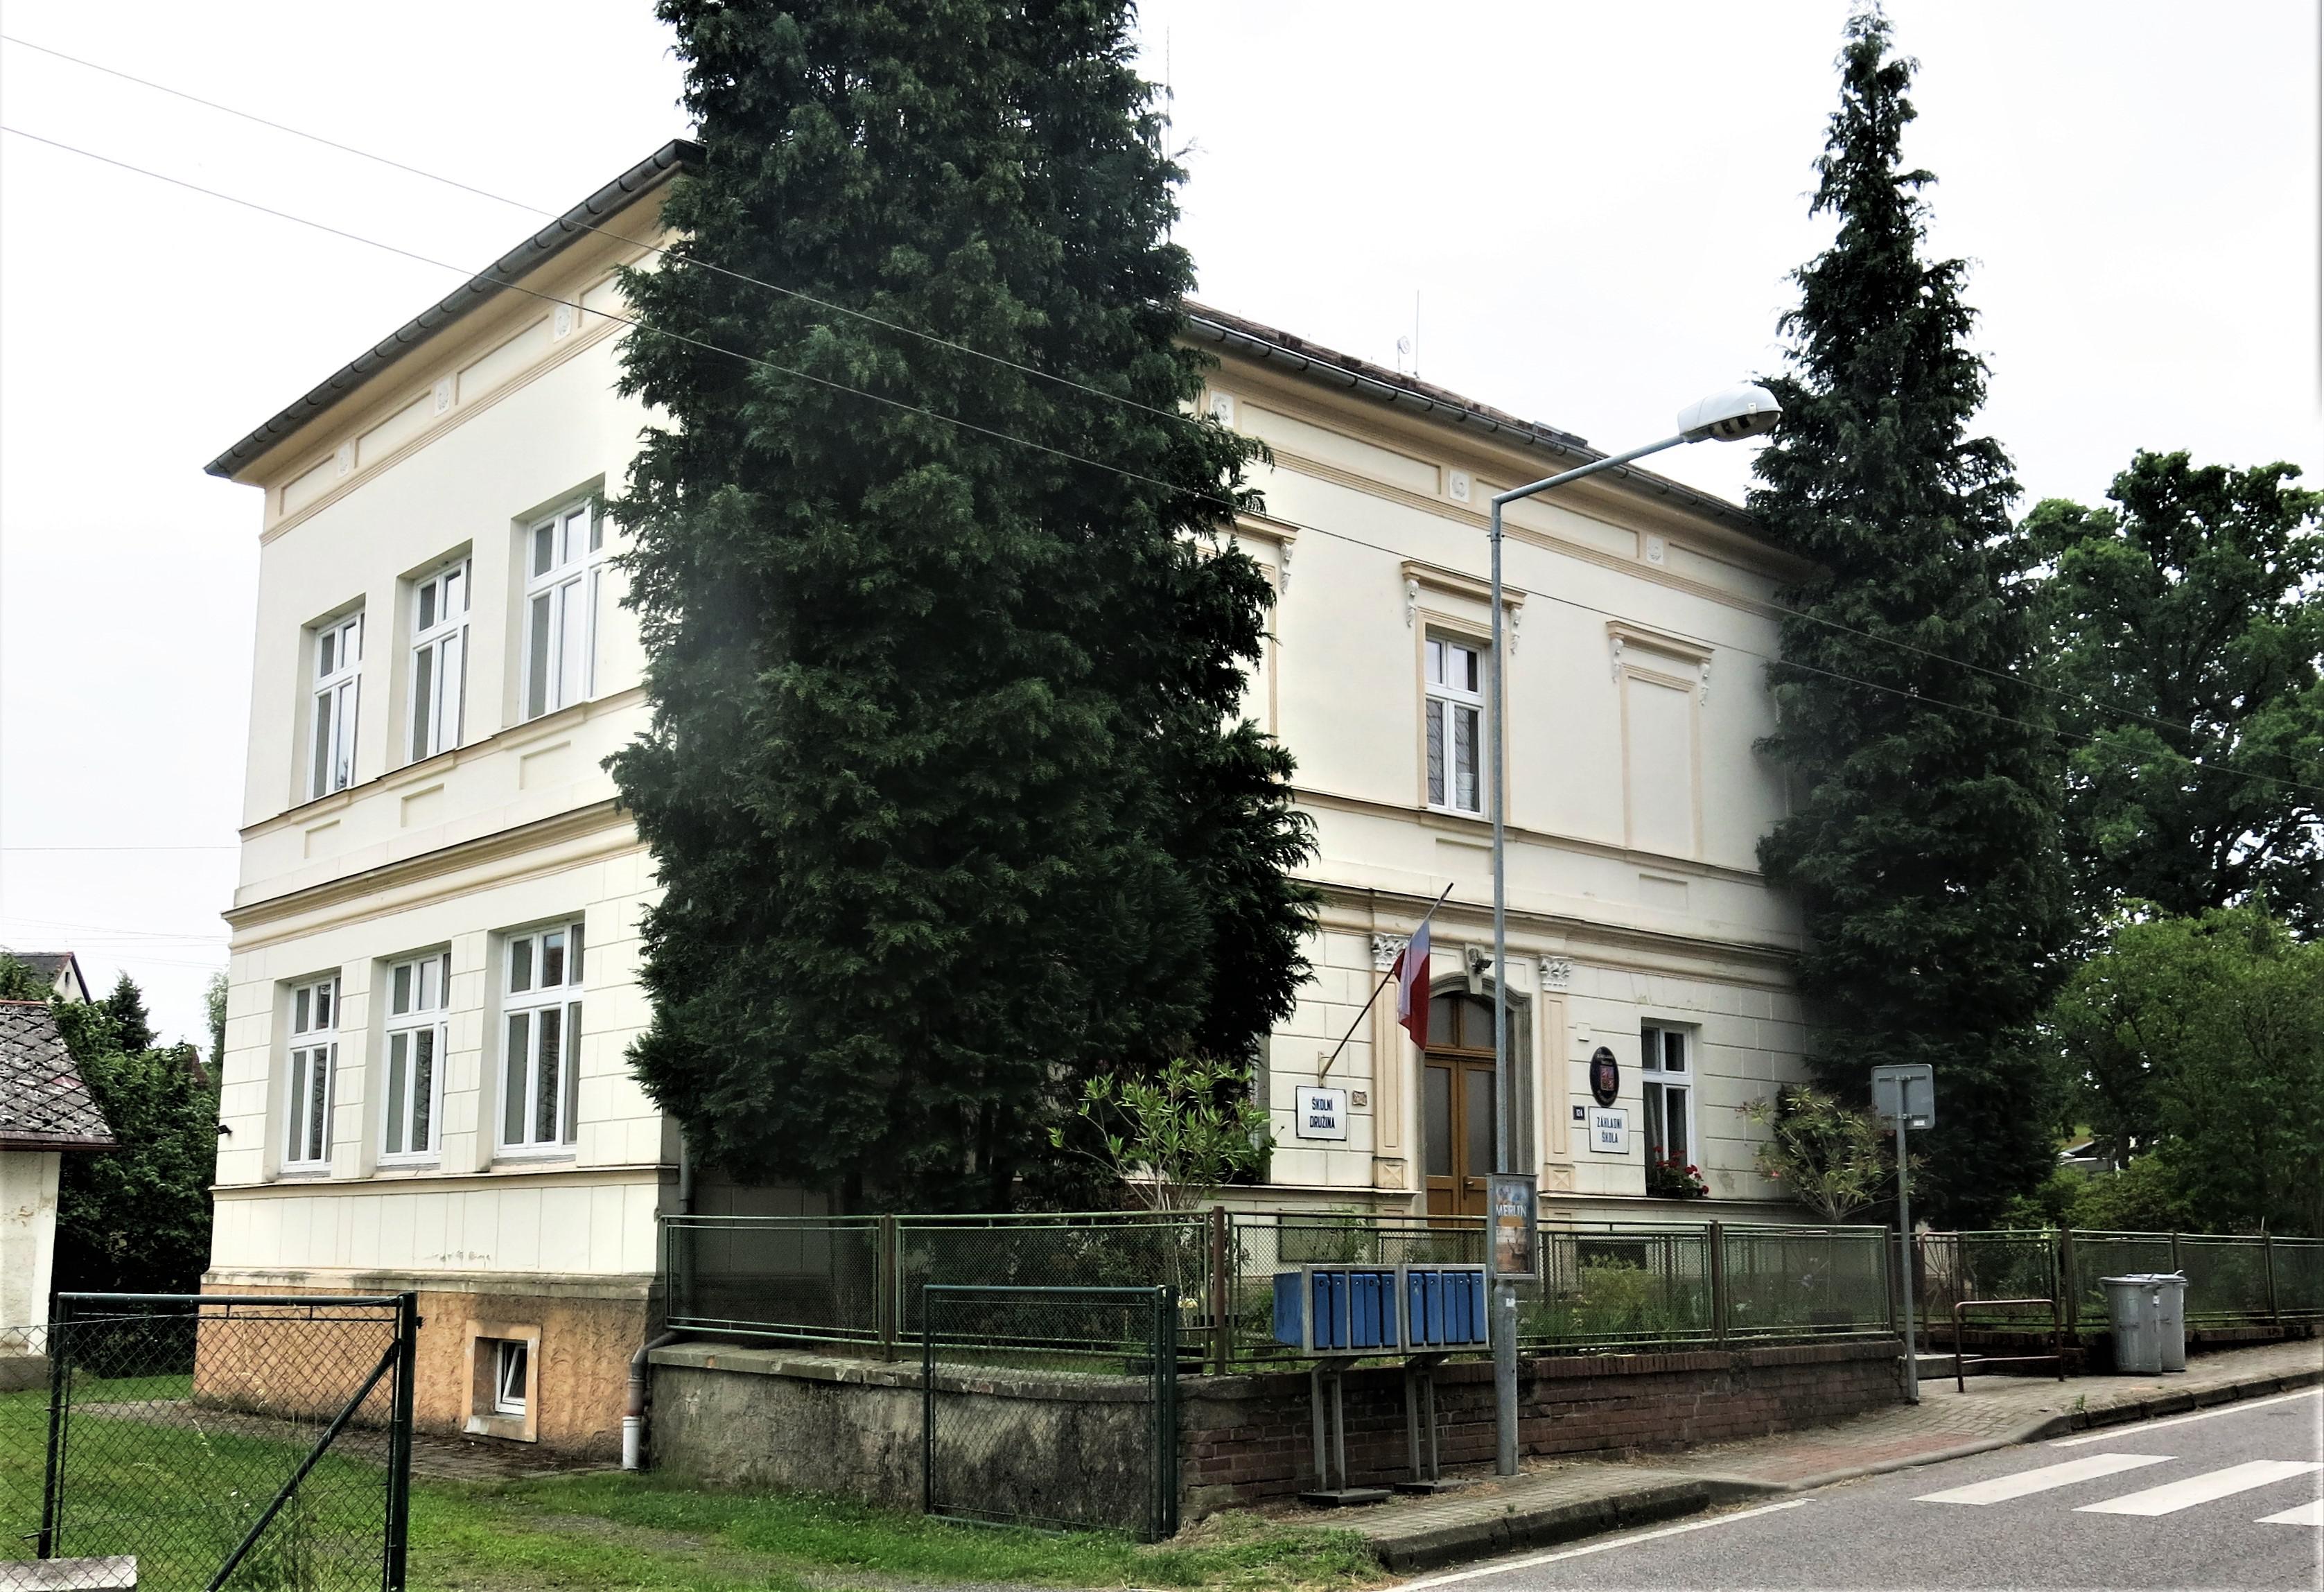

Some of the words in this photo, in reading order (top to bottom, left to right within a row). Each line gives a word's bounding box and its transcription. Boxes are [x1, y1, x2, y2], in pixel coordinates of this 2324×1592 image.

[1311, 1096, 1334, 1111] ŠKOLNÍ
[1309, 1114, 1336, 1129] DRUŽINA
[1596, 1115, 1623, 1129] ZÁKLADNÍ
[1602, 1130, 1618, 1144] ŠKOLA
[1495, 1204, 1527, 1217] MERLIN
